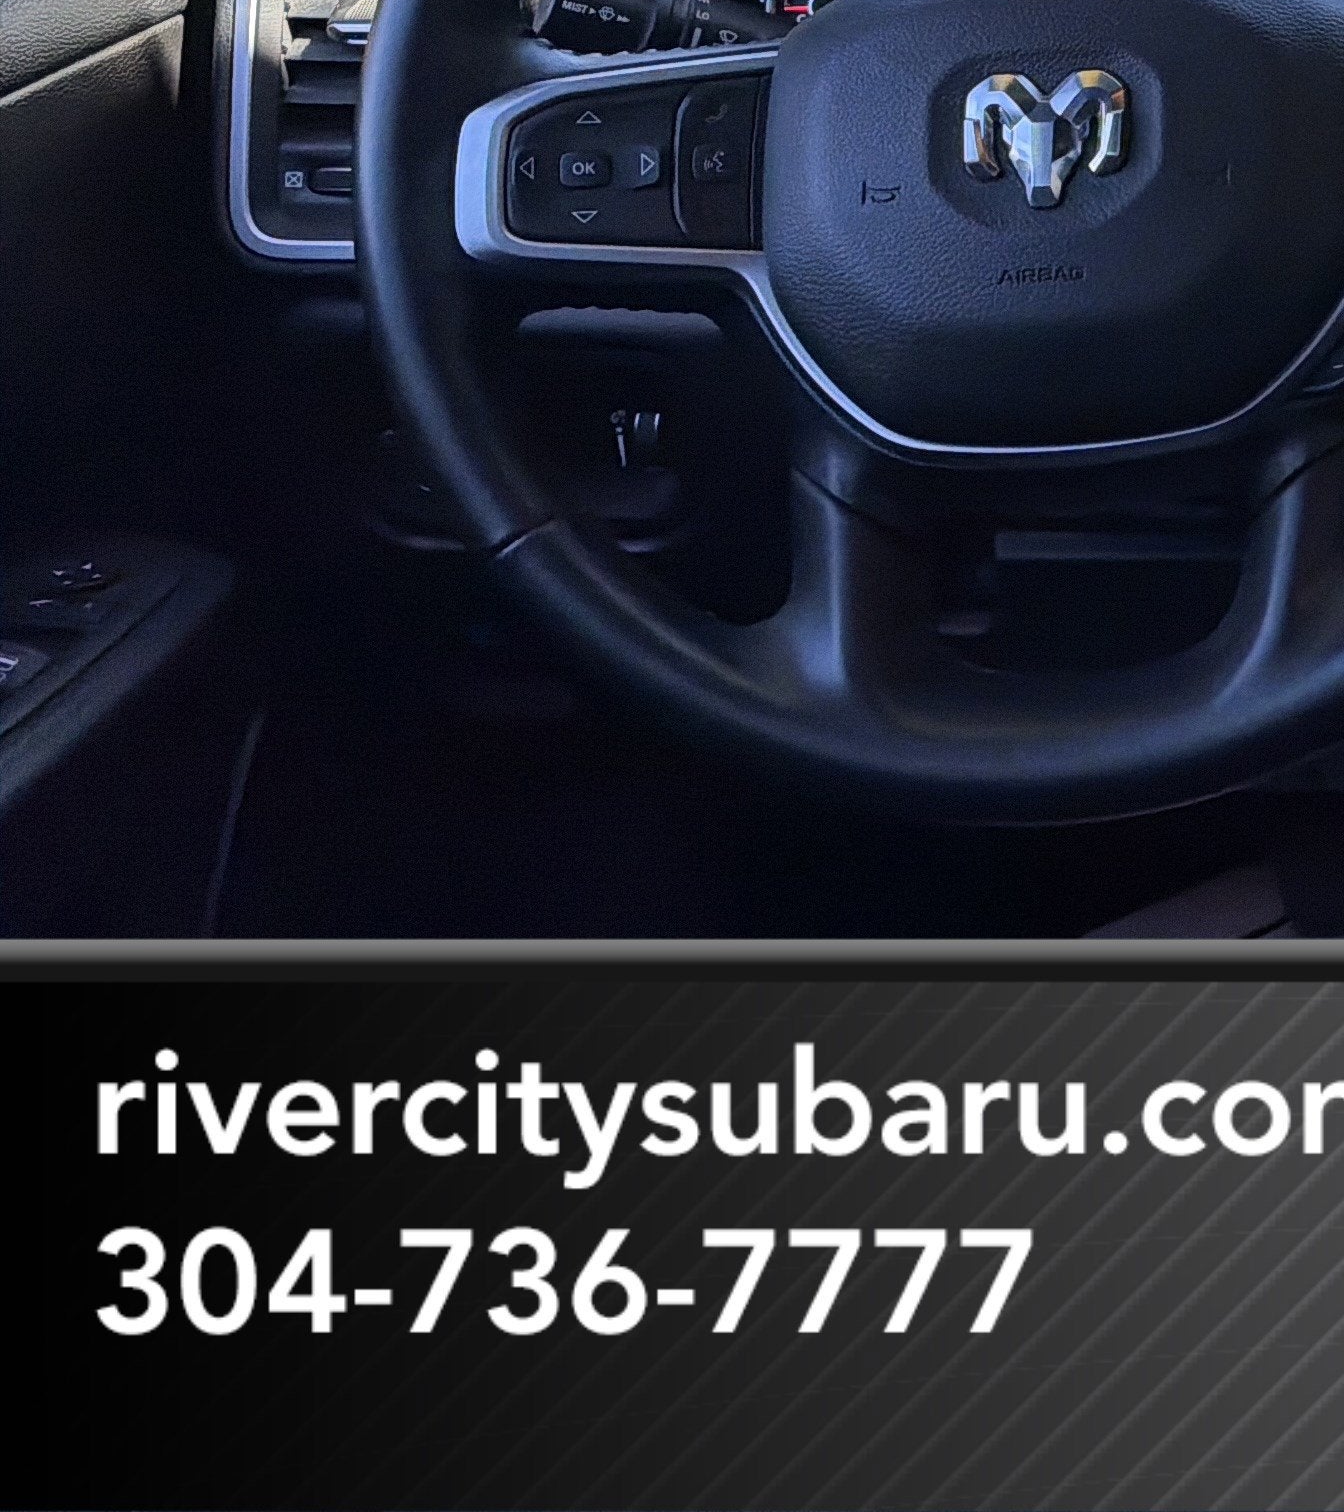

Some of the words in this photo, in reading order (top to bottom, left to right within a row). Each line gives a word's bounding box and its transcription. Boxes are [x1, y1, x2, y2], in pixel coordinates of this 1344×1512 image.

[696, 11, 711, 21] LO
[571, 161, 596, 176] OK
[998, 265, 1087, 286] AIRBAG
